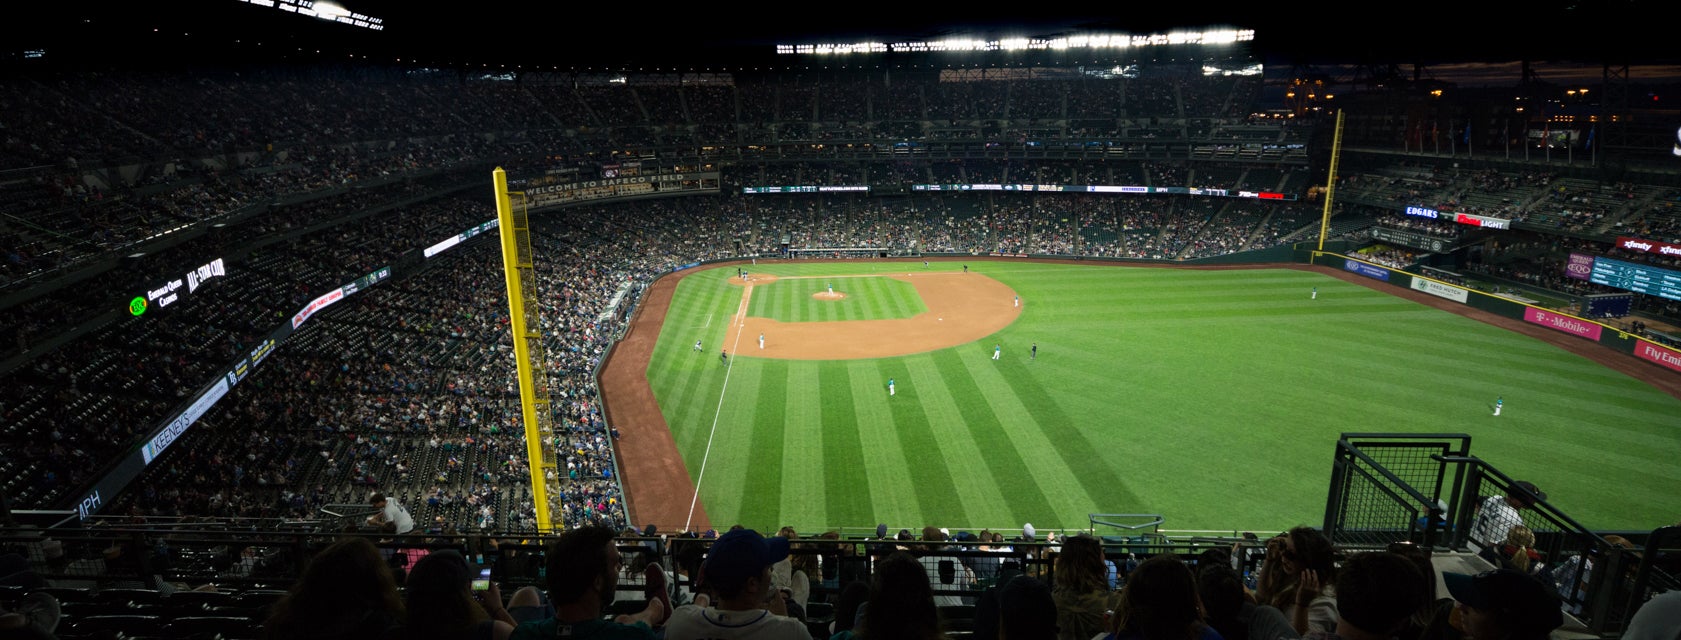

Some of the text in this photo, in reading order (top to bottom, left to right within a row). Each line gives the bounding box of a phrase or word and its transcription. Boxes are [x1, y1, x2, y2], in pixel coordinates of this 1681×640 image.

[526, 183, 578, 196] WELCOME
[602, 177, 646, 186] SAFECO
[1406, 206, 1438, 219] EDGARS
[1481, 219, 1504, 229] LIGHT
[1624, 240, 1652, 251] xfinity
[1444, 287, 1462, 295] HUTCH
[1645, 346, 1661, 360] Fly
